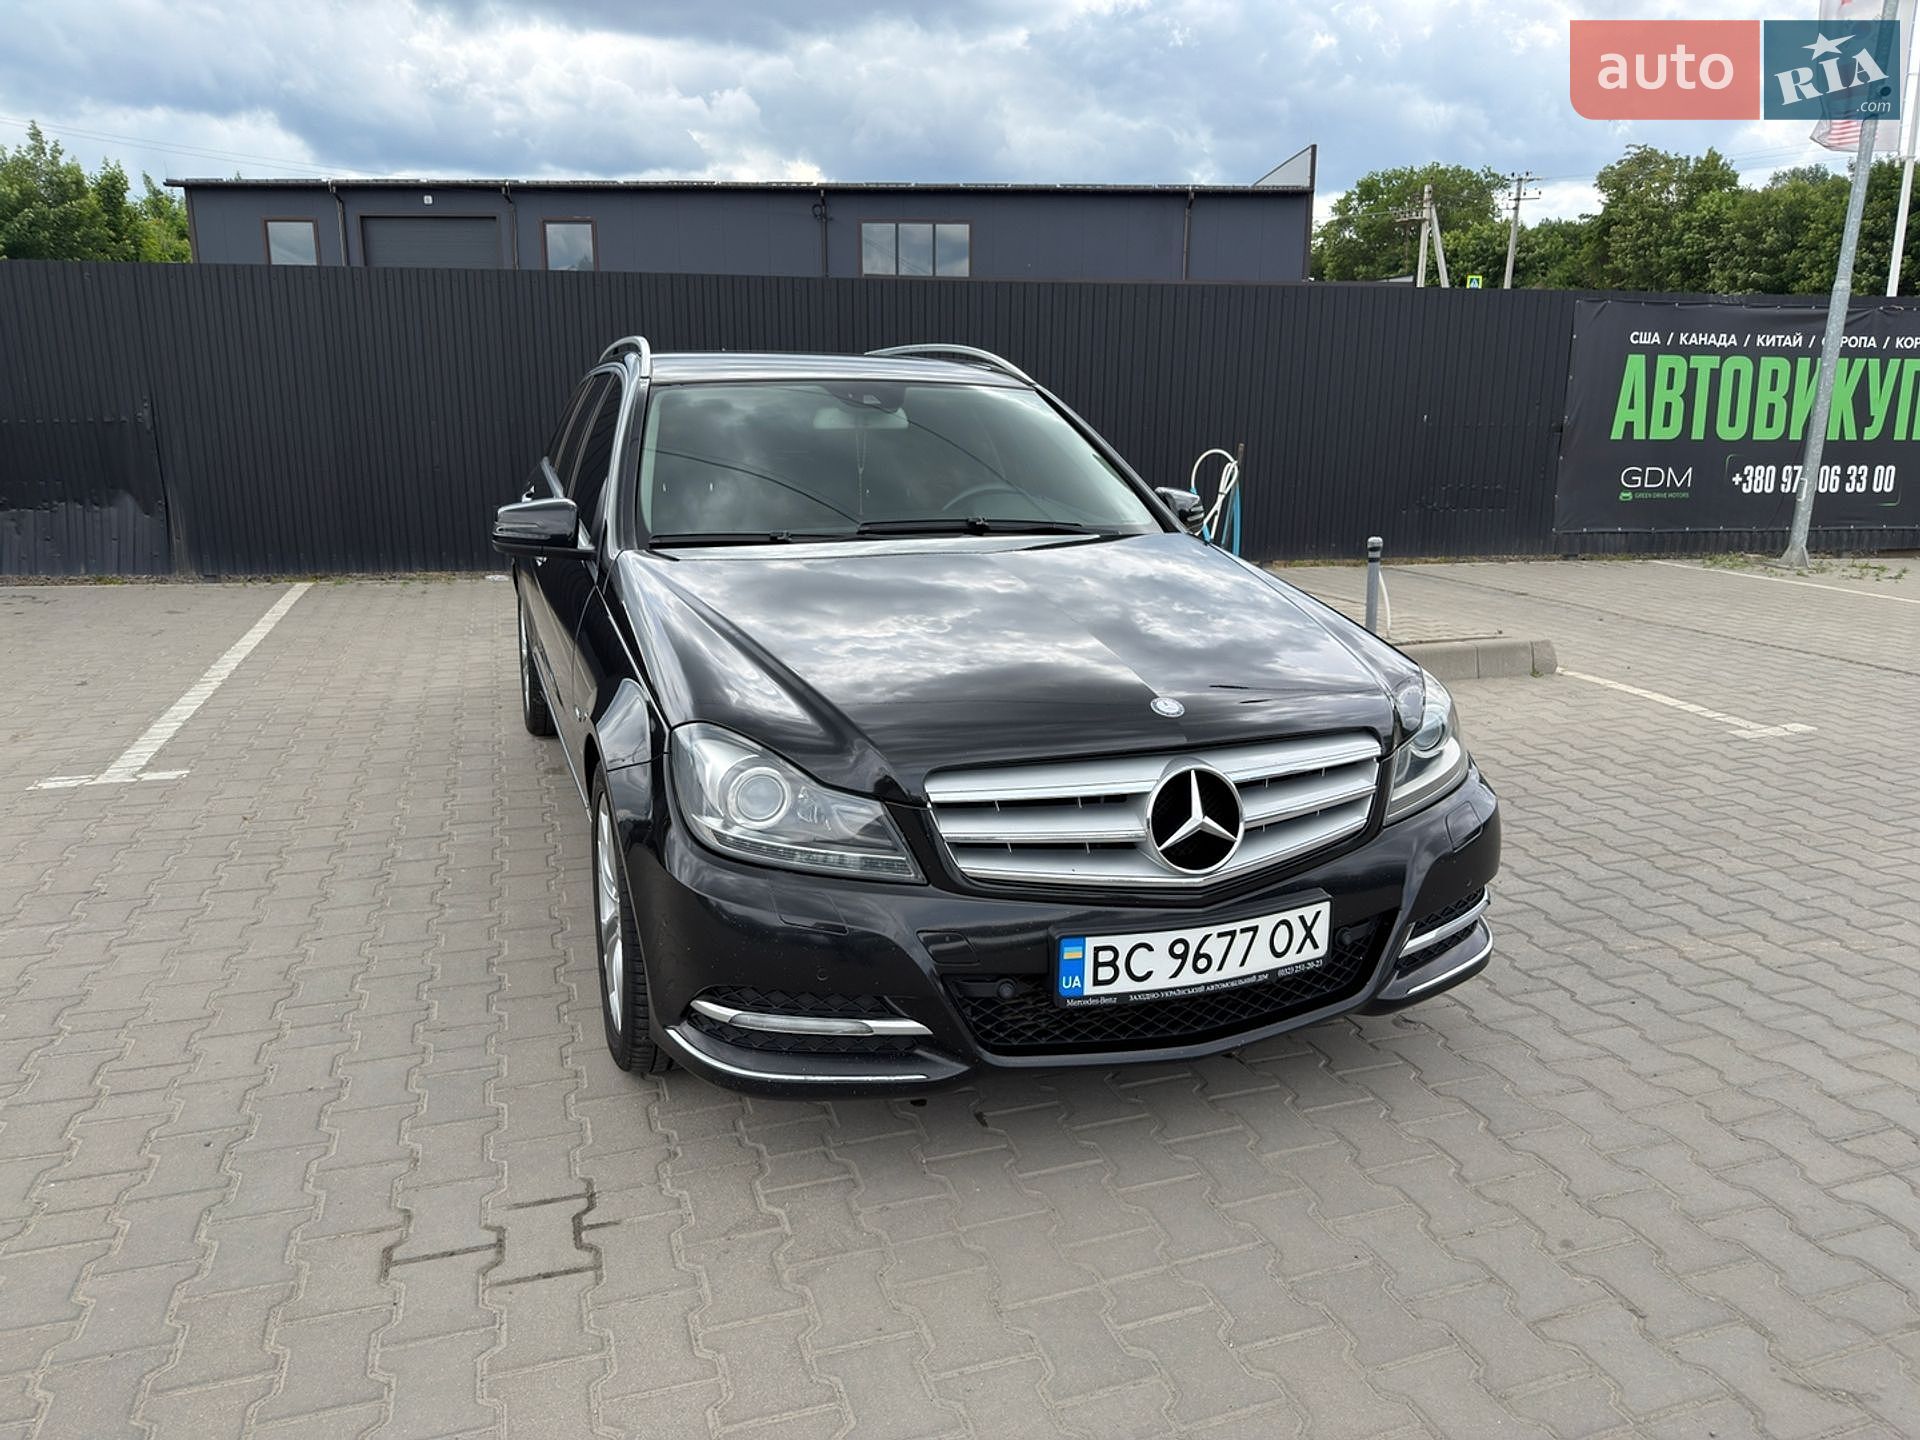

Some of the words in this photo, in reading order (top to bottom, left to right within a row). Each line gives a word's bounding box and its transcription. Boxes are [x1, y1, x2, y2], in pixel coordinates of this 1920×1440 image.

[1629, 331, 1661, 345] США
[1679, 332, 1738, 348] КАНАДА
[1756, 332, 1803, 347] КИТАЙ
[1821, 336, 1877, 348] РОПА
[1609, 354, 1920, 441] АВТОВИКУП
[1621, 466, 1693, 488] GDM
[1732, 465, 1776, 493] +380
[1817, 465, 1841, 493] 06
[1845, 465, 1868, 493] 33
[1872, 465, 1896, 493] 00
[1092, 942, 1154, 987] BC
[1168, 925, 1259, 979] 9677
[1269, 910, 1322, 958] OX
[1062, 975, 1081, 989] UA
